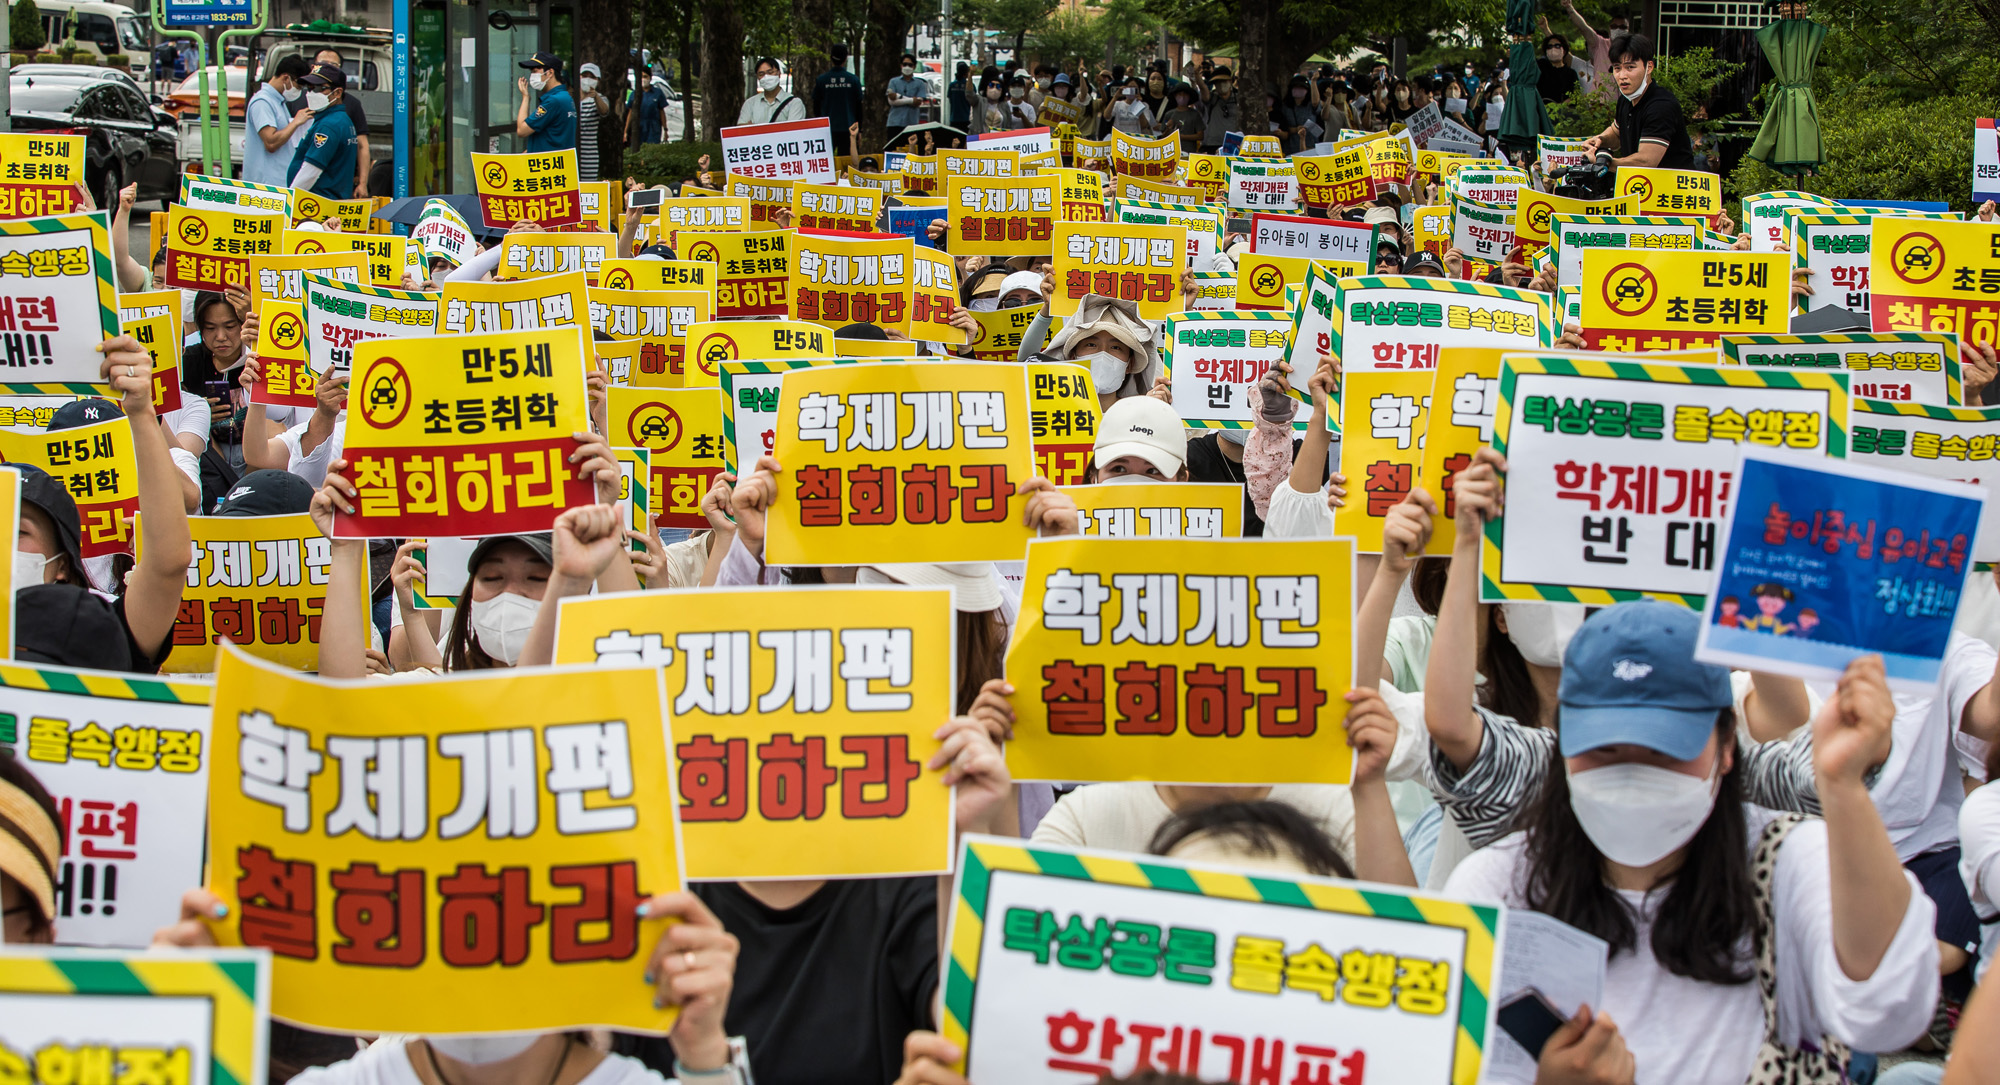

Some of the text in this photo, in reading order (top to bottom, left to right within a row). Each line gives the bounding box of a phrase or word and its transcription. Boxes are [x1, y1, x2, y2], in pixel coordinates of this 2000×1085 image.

[211, 13, 247, 21] 1833-6751
[29, 140, 70, 157] 만5세
[727, 139, 826, 163] 전문성은 어디 가고
[1116, 138, 1175, 162] 학제개편
[1386, 140, 1399, 148] 만5
[1542, 142, 1566, 152] 탁상공론
[7, 163, 70, 180] 초등취학
[528, 156, 565, 173] 만5세
[780, 158, 829, 175] 학제 개편
[902, 159, 937, 175] 학제개
[946, 156, 1012, 177] 학제개편
[1116, 158, 1177, 176] 철회하라
[1233, 165, 1265, 176] 탁상공론
[1335, 151, 1360, 168] 만5세
[1371, 163, 1407, 180] 회하라
[512, 175, 566, 193] 초등취학
[853, 174, 902, 193] 학제개편
[1076, 173, 1097, 187] 만5세
[1324, 165, 1364, 183] 초등취학
[1461, 174, 1526, 184] 탁상공론 졸속행정
[1676, 175, 1710, 192] 만5세
[191, 187, 284, 211] 탁상공론 졸속행정
[960, 186, 1053, 213] 학제개편
[1063, 188, 1099, 200] 초등취학
[1240, 181, 1289, 193] 학제개편
[1245, 193, 1285, 205] 반 대!!
[1305, 180, 1369, 204] 철회하라
[1468, 189, 1517, 202] 학제개편
[0, 188, 73, 216] 회하라
[338, 205, 363, 215] 만5세
[487, 195, 572, 223] 철회하라
[801, 191, 873, 216] 학제개편
[1656, 193, 1712, 211] 초등취학
[233, 219, 272, 234] 만5세
[669, 206, 742, 226] 학제개편
[1459, 206, 1503, 224] 탁상공론
[960, 216, 1054, 241] 철회하라
[1258, 228, 1309, 248] 유아들이
[1318, 232, 1358, 253] 봉이냐
[1564, 231, 1692, 249] 탁상공론 졸속행정
[212, 238, 272, 255] 초등취학
[438, 236, 460, 254] 대!!
[744, 236, 785, 254] 만5세
[1067, 234, 1174, 267] 학제개편
[1421, 252, 1432, 261] NY
[1476, 240, 1492, 254] 반
[1813, 234, 1870, 254] 탁상공
[0, 246, 90, 278] 속행정
[176, 254, 248, 288] 철회하
[508, 244, 606, 273] 학제개편
[726, 258, 788, 274] 초등취학
[799, 249, 905, 286] 학제개편
[662, 267, 704, 285] 만5세
[914, 258, 954, 291] 개편
[1066, 269, 1175, 302] 철회하라
[1702, 261, 1769, 289] 만5세
[1952, 267, 2000, 294] 초등
[311, 291, 434, 326] 탁상공론 졸속행정
[446, 291, 575, 334] 학제개편
[797, 286, 907, 324] 철회하라
[1665, 296, 1769, 325] 초등취학
[590, 300, 696, 337] 학제개편
[1350, 301, 1535, 337] 탁상공론 졸속행정
[1888, 302, 2000, 350] 철회하
[773, 329, 824, 354] 만5세
[1178, 329, 1288, 348] 탁상공론 졸속
[462, 342, 554, 384] 만5세
[1372, 341, 1440, 370] 학제
[1845, 352, 1942, 372] 졸속행정
[1193, 358, 1270, 384] 학제개
[1034, 374, 1090, 401] 만5세
[1207, 385, 1232, 409] 반
[424, 392, 559, 434] 초등취학
[798, 391, 1008, 452] 학제개편
[1032, 410, 1095, 438] 등취학
[1523, 395, 1821, 448] 탁상공론 졸속행정
[1129, 424, 1154, 437] Jeep
[46, 432, 115, 467] 만5세
[1852, 426, 2000, 461] 공론 졸속행
[58, 469, 120, 498] 취학
[354, 447, 571, 517] 철회하라
[796, 463, 1016, 527] 철회하라
[1582, 515, 1633, 565] 반
[1763, 502, 1877, 560] 놀이중심
[1880, 528, 1968, 574] 유아교육
[189, 537, 332, 587] 제개편
[1041, 568, 1321, 649] 학제개편
[1040, 658, 1329, 740] 철회하라
[27, 716, 202, 775] 졸속행정
[238, 708, 639, 844] 학제개편
[676, 732, 921, 824] 회하라
[235, 843, 654, 971] 철회하라
[1002, 905, 1451, 1018] 탁상공론 졸속행정
